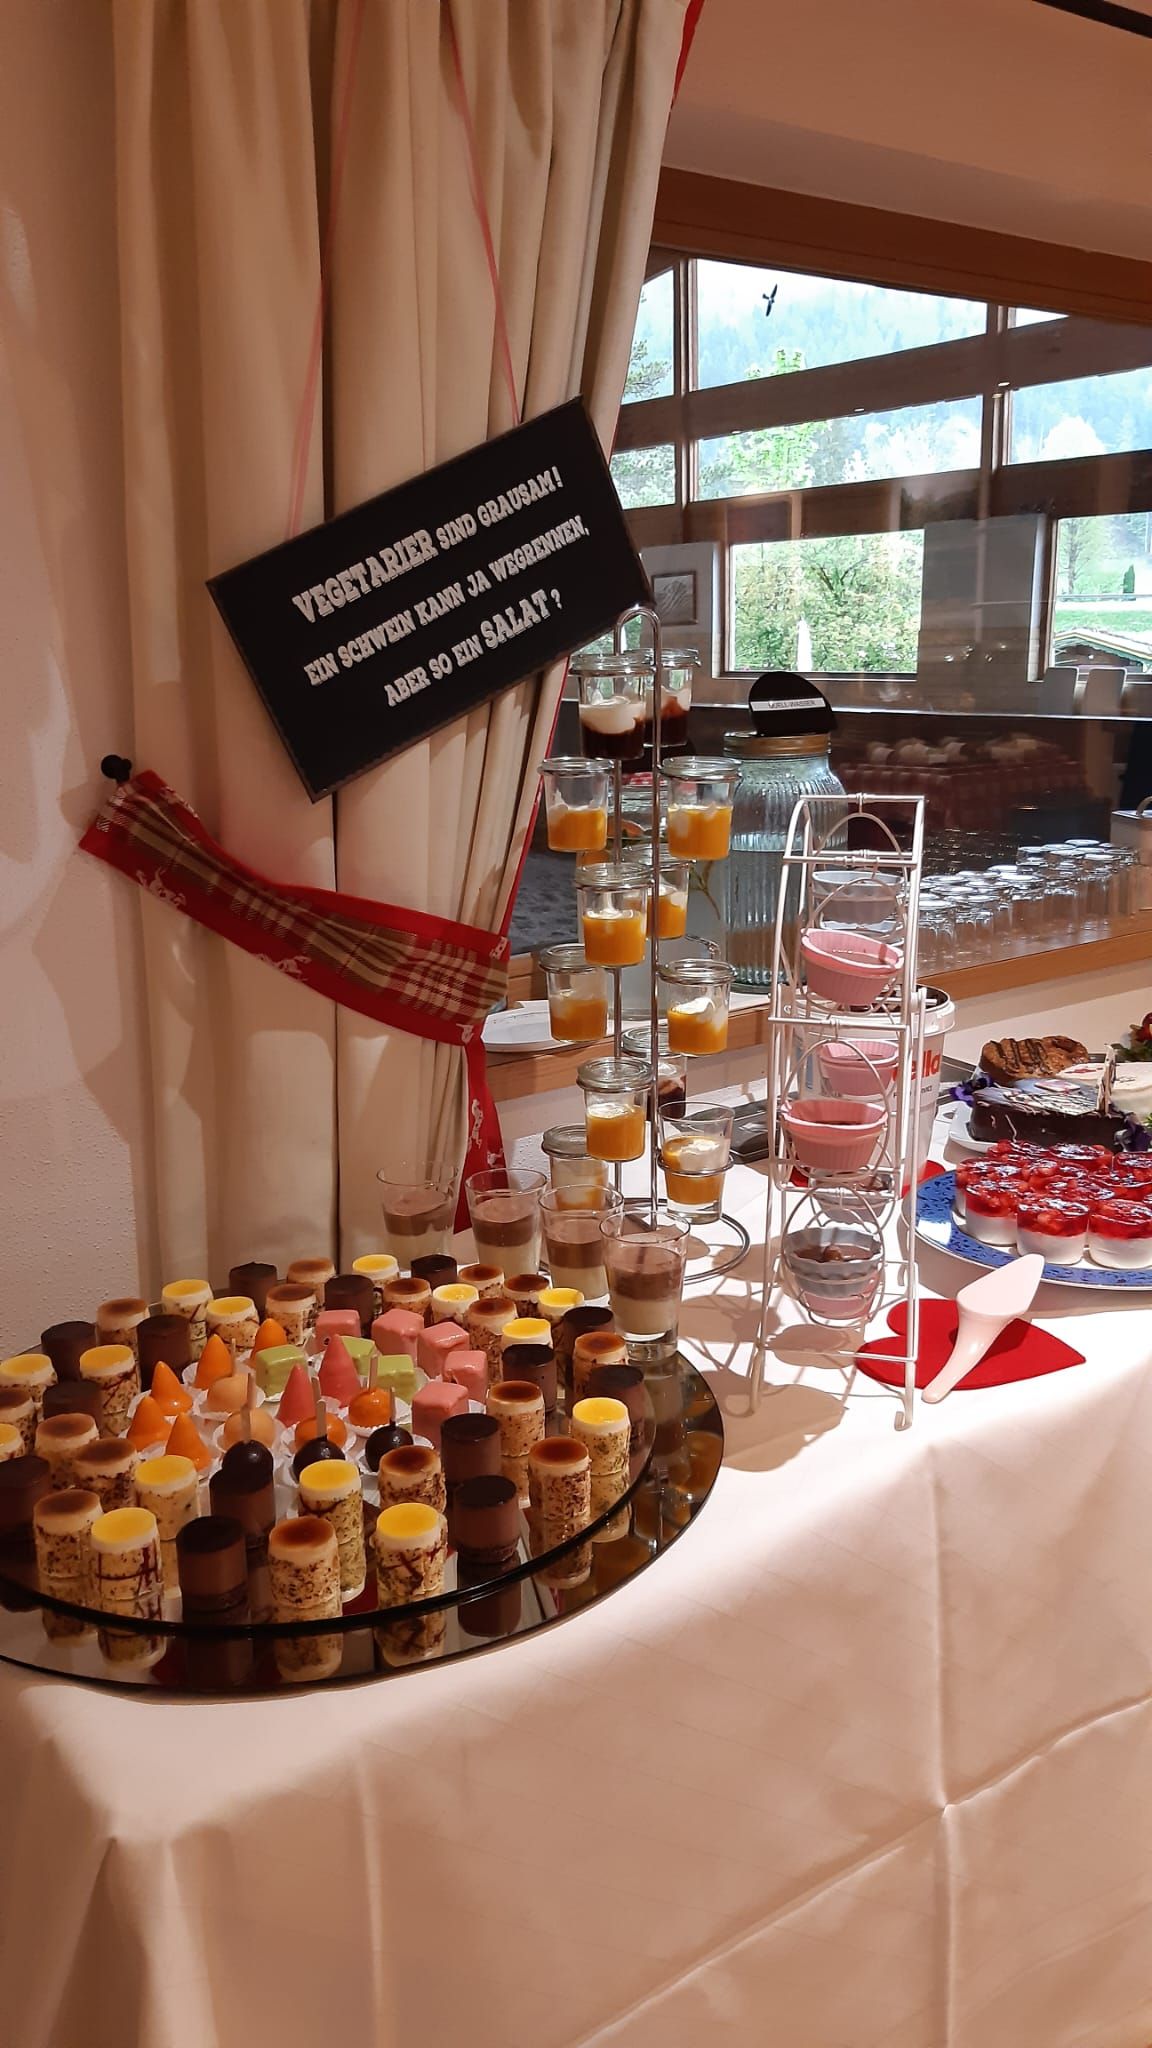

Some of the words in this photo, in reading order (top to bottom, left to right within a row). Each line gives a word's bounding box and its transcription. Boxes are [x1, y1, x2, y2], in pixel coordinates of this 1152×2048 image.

[292, 529, 438, 623] VEGETARIER
[436, 513, 477, 550] SIND
[476, 466, 563, 527] GRAUSAM!
[304, 653, 340, 687] EIN
[338, 609, 416, 668] SCHWEIN
[413, 583, 466, 626] KANN
[467, 570, 491, 597] JA
[488, 515, 590, 582] WEGRENNEN,
[384, 666, 431, 707] ABER
[428, 653, 452, 679] SO
[451, 635, 484, 667] EIN
